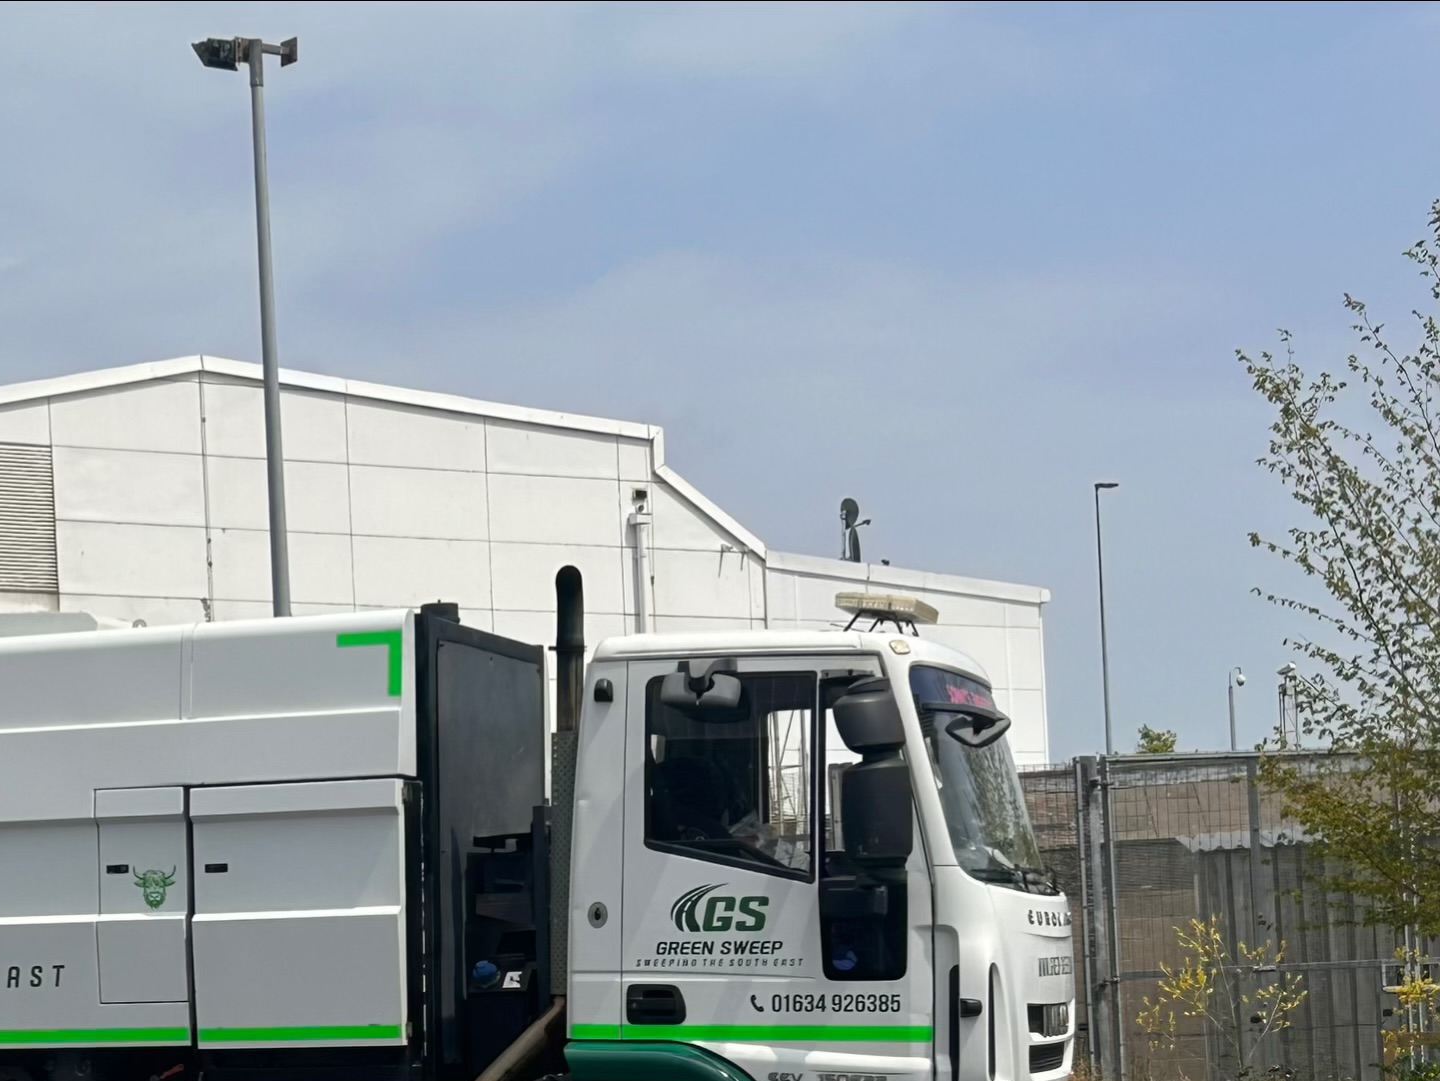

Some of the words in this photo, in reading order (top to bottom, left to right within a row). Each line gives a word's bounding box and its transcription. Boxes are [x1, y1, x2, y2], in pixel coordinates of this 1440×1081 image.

[702, 895, 770, 932] GS
[655, 940, 715, 956] GREEN
[719, 940, 784, 955] SWEEP
[635, 958, 698, 968] SWEEPING
[702, 958, 724, 967] THE
[728, 958, 769, 967] SOUTH
[773, 958, 804, 967] EAST
[771, 993, 827, 1013] 01634
[831, 993, 902, 1013] 926385
